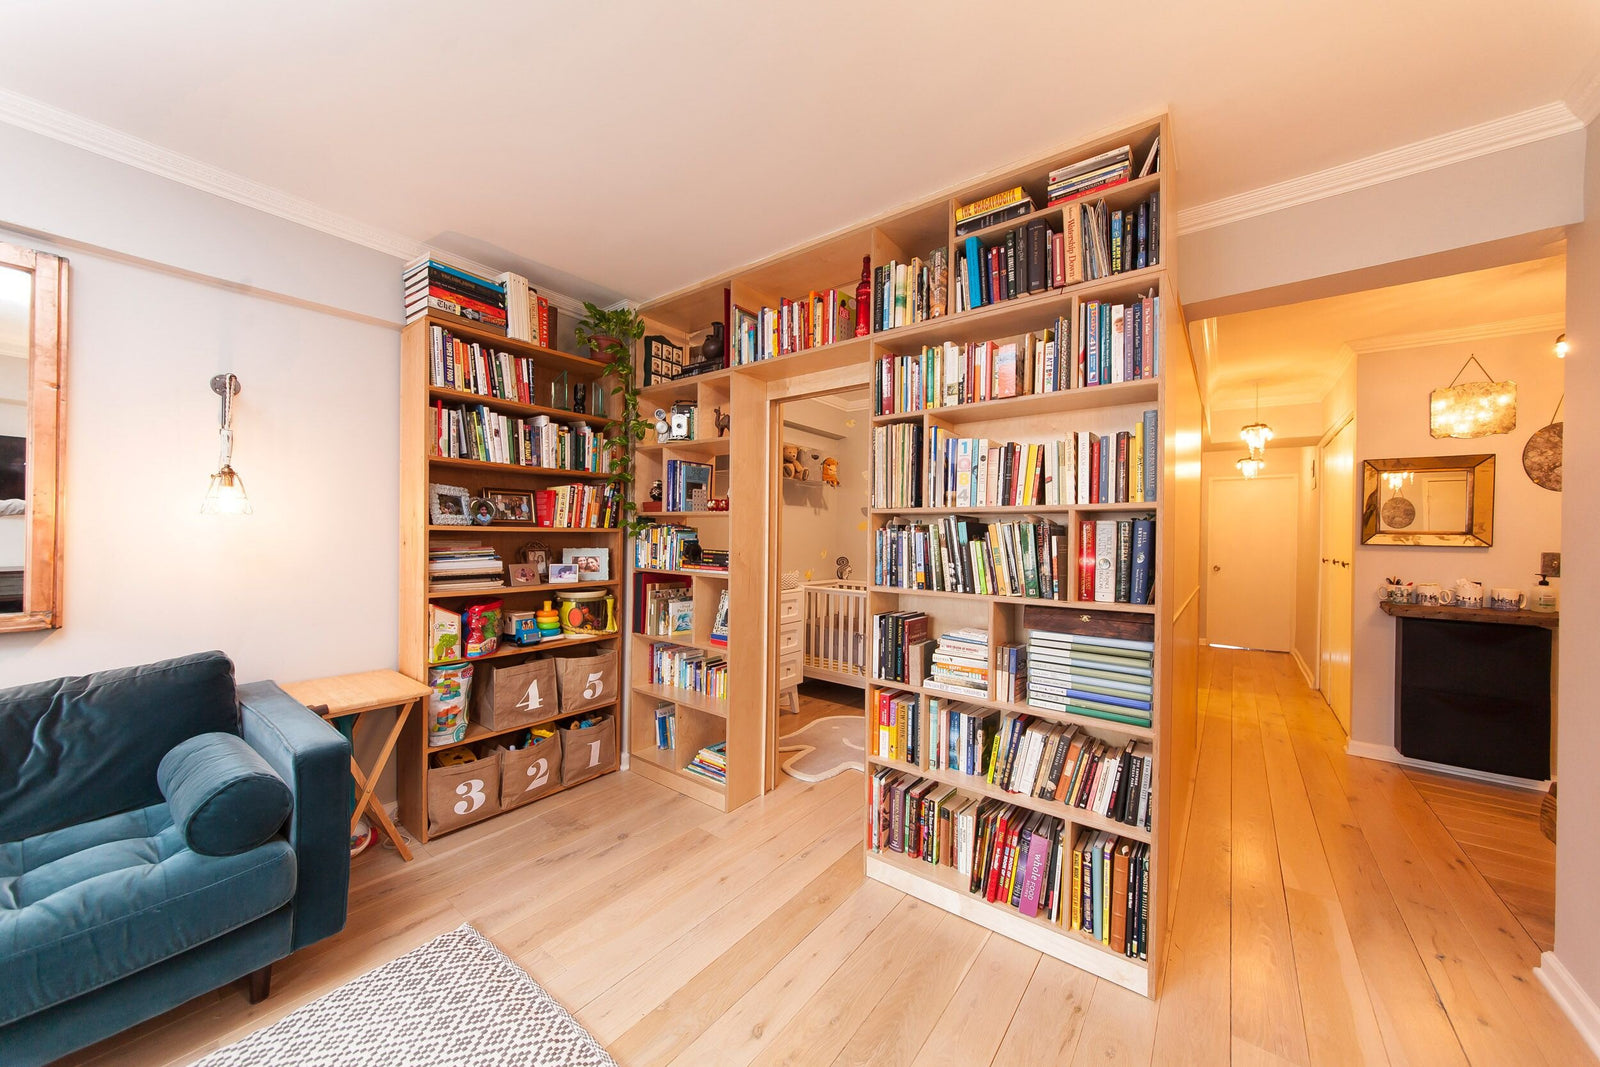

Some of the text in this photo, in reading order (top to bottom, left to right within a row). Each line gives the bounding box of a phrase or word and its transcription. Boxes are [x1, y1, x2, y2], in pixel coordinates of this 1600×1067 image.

[1067, 218, 1076, 254] Watership
[1068, 255, 1076, 278] Down
[515, 679, 544, 712] 4
[583, 671, 604, 700] 5
[585, 740, 601, 769] 1
[525, 758, 550, 792] 2
[453, 779, 486, 815] 3
[1028, 853, 1043, 901] whole FOOD
